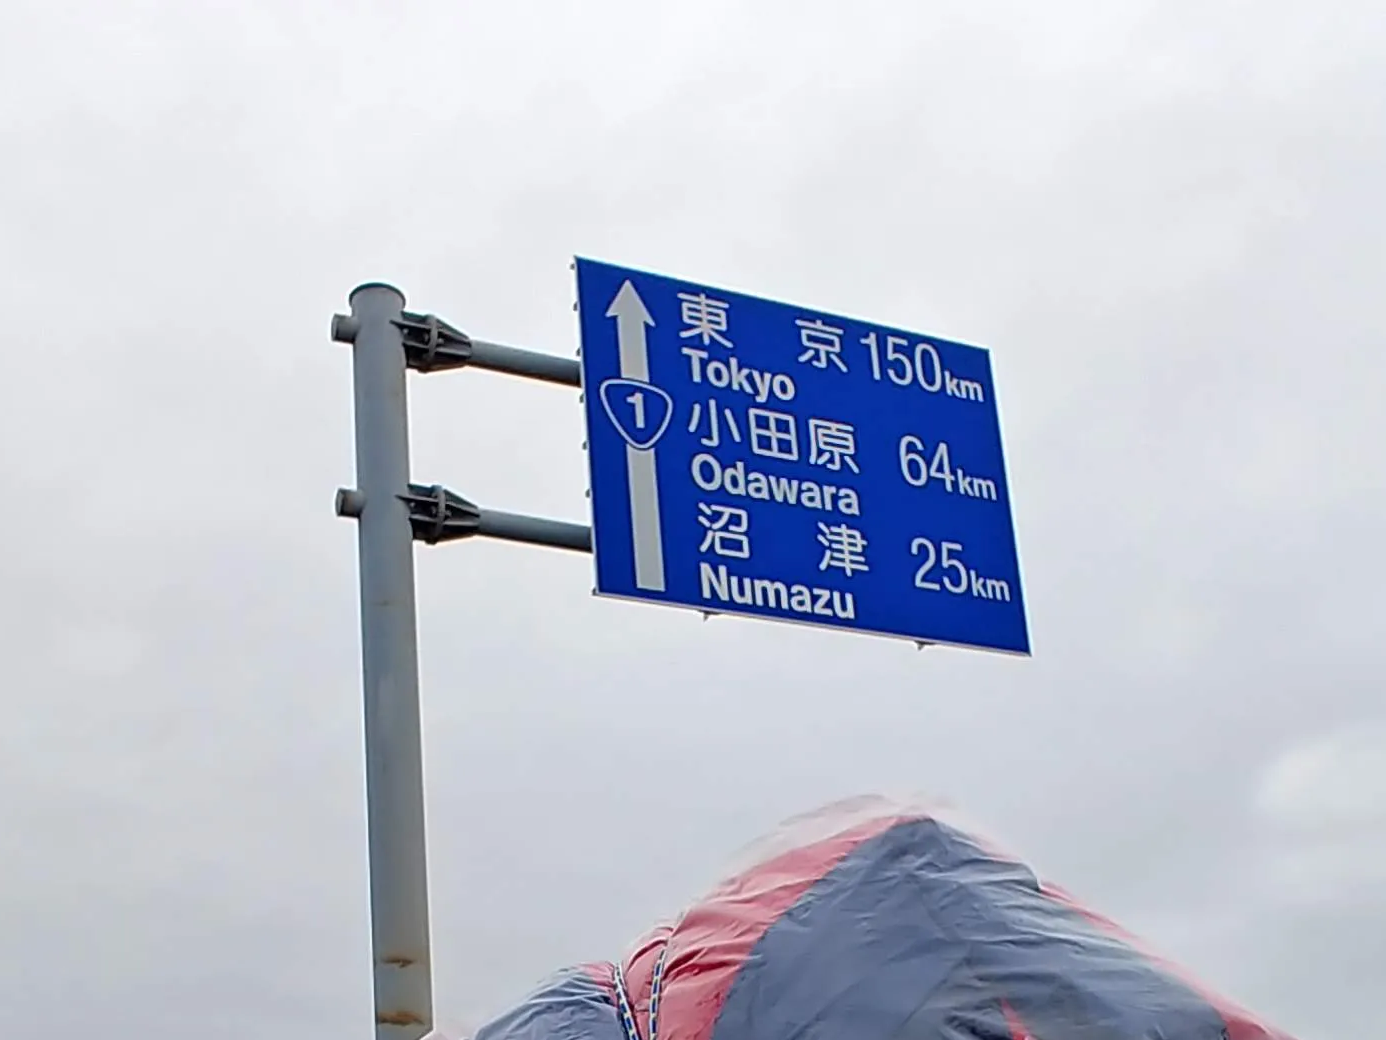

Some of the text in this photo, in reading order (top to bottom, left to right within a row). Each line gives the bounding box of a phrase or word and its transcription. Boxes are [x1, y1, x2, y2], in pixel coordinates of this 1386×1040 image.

[677, 292, 848, 372] 東京
[681, 347, 796, 402] Tokyo
[626, 392, 646, 429] 1
[687, 398, 860, 474] 小田原
[690, 454, 860, 516] Odawara
[696, 502, 869, 577] 沼津
[699, 562, 856, 619] Numazu
